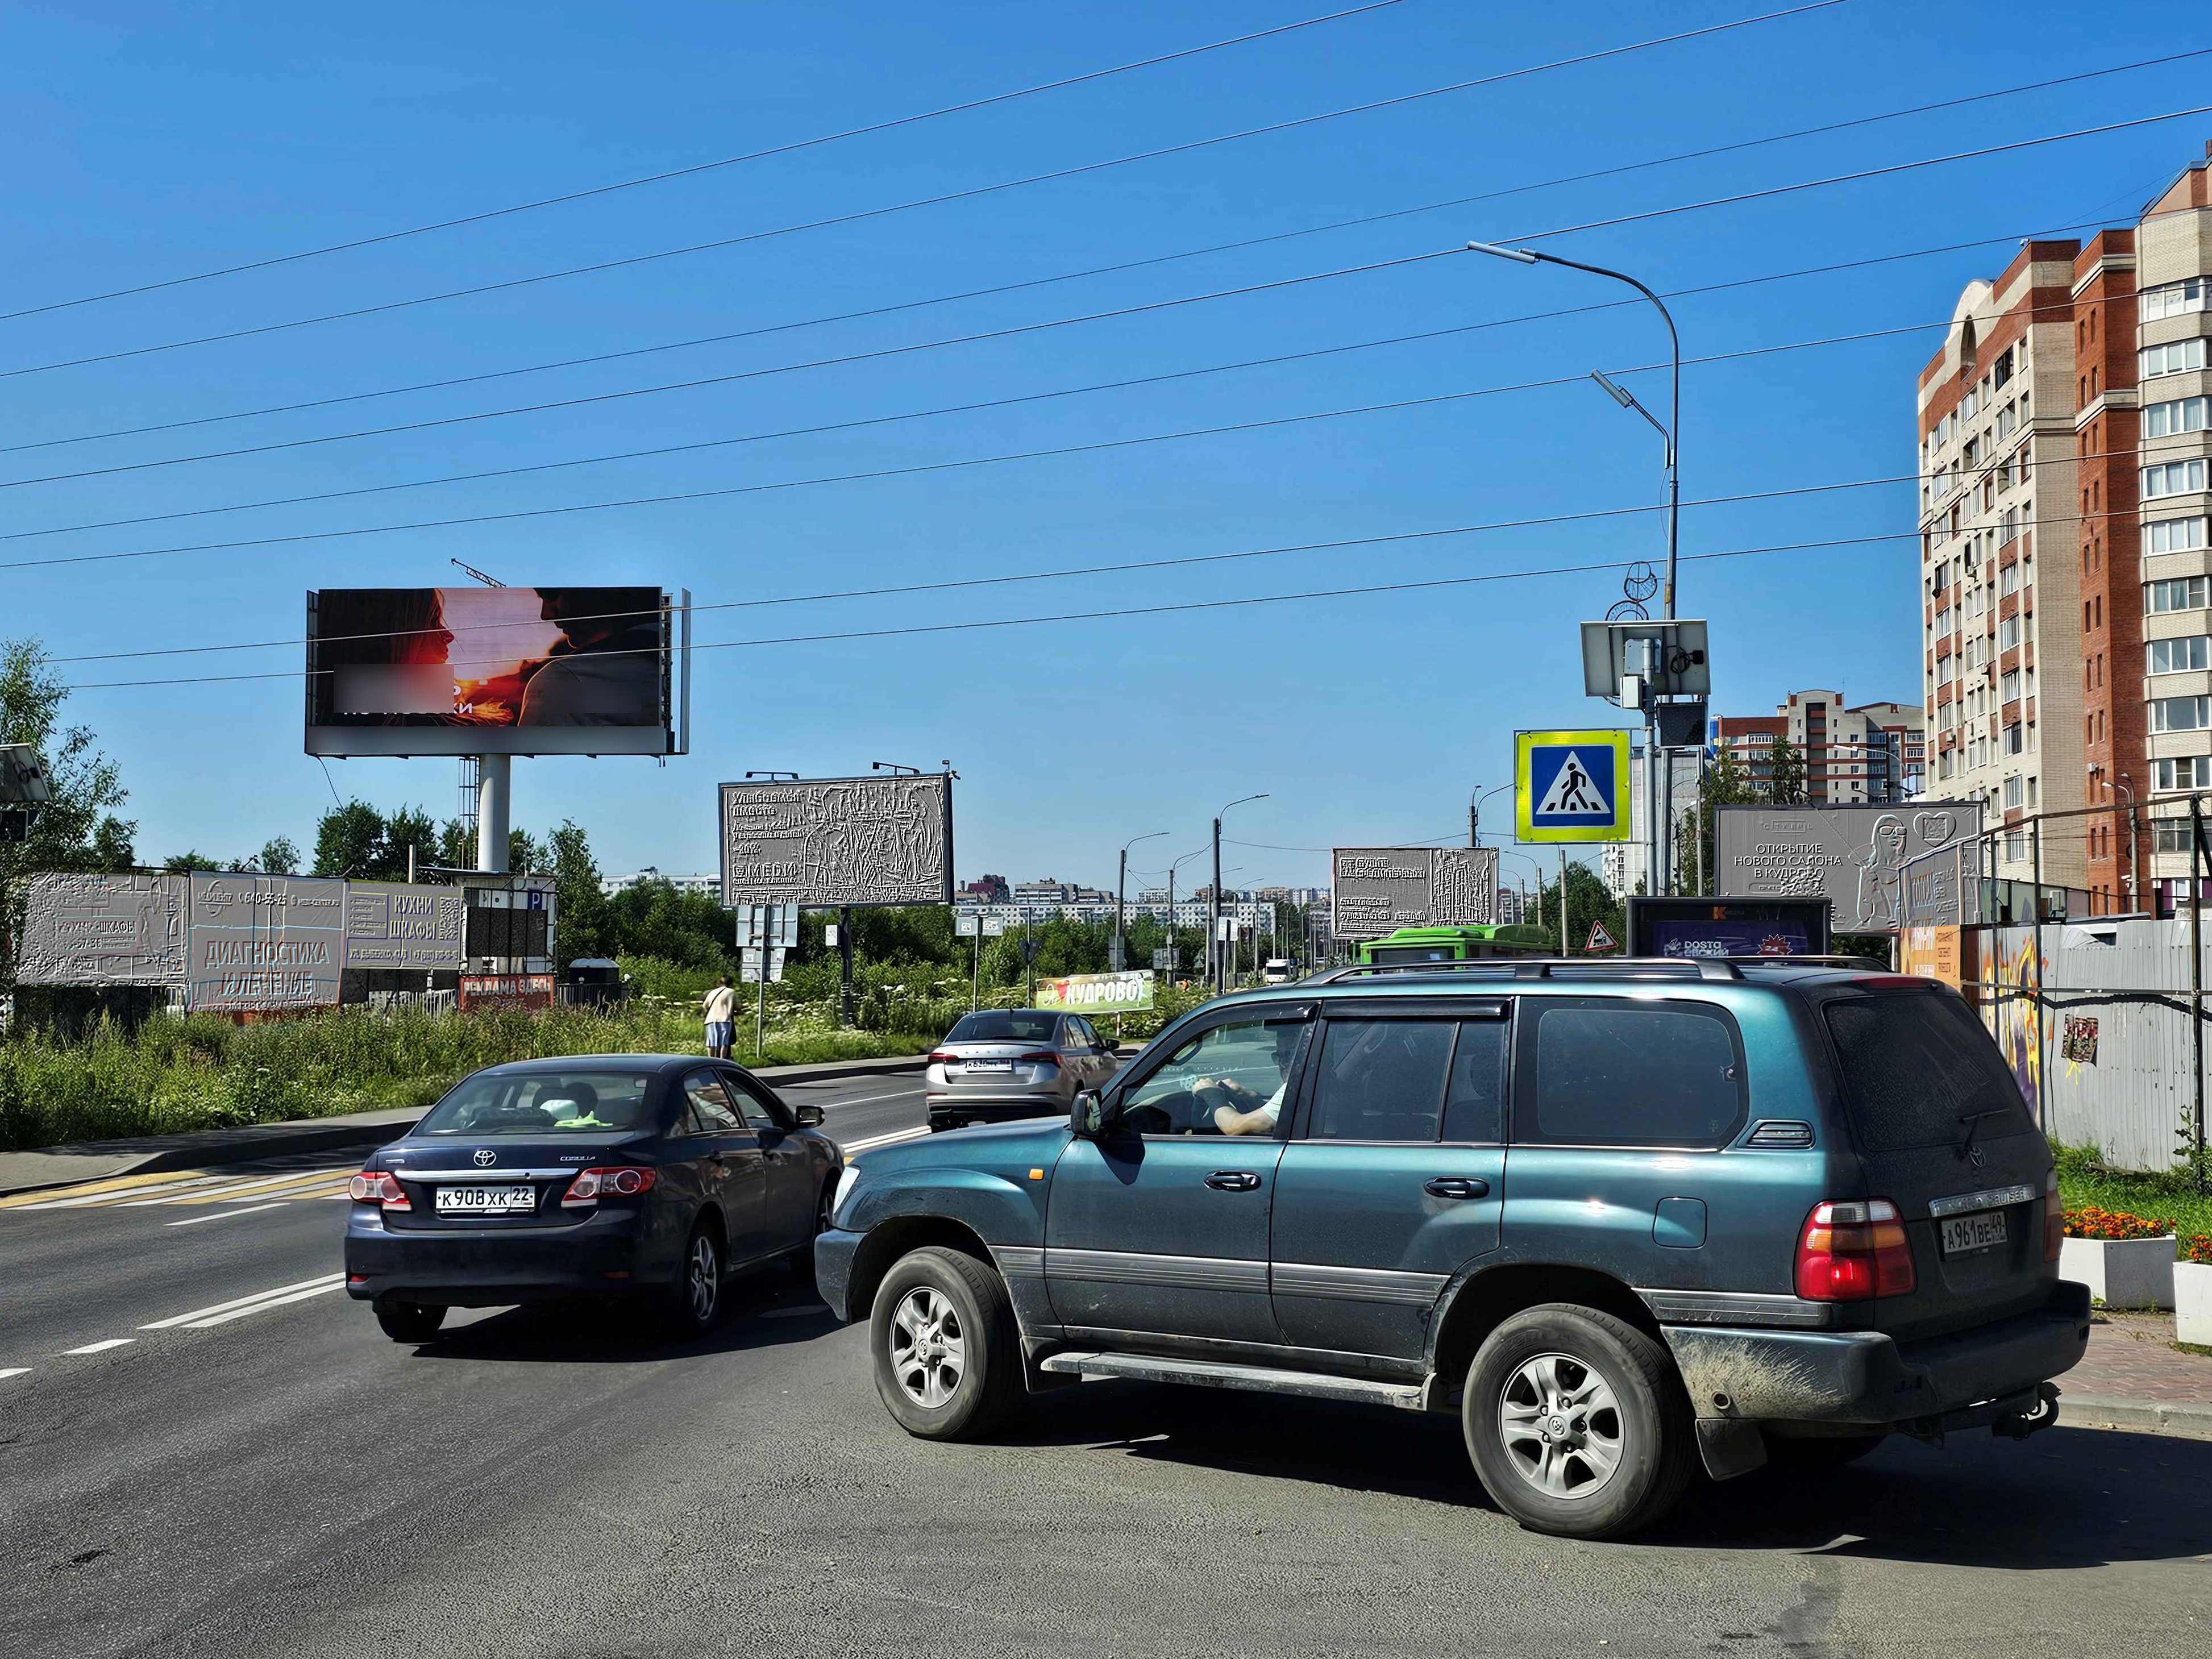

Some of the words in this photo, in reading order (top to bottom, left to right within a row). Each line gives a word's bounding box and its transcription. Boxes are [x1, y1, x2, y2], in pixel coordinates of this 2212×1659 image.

[1756, 843, 1823, 854] ОТКРЫТИЕ
[1734, 856, 1786, 866] НОВОГО
[1789, 855, 1843, 866] САЛОНА
[1754, 868, 1763, 878] В
[394, 895, 434, 915] КУХНИ
[99, 921, 136, 934] ШКАФЫ
[389, 920, 436, 941] ШКАФЫ
[205, 941, 330, 969] ДИАГНОСТИКА
[222, 971, 235, 996] И
[237, 971, 313, 996] ЛЕЧЕНИЕ
[463, 979, 517, 996] РЕКЛАМА
[519, 978, 551, 995] ЗДЕСЬ
[1066, 979, 1138, 1005] КУДРОВО
